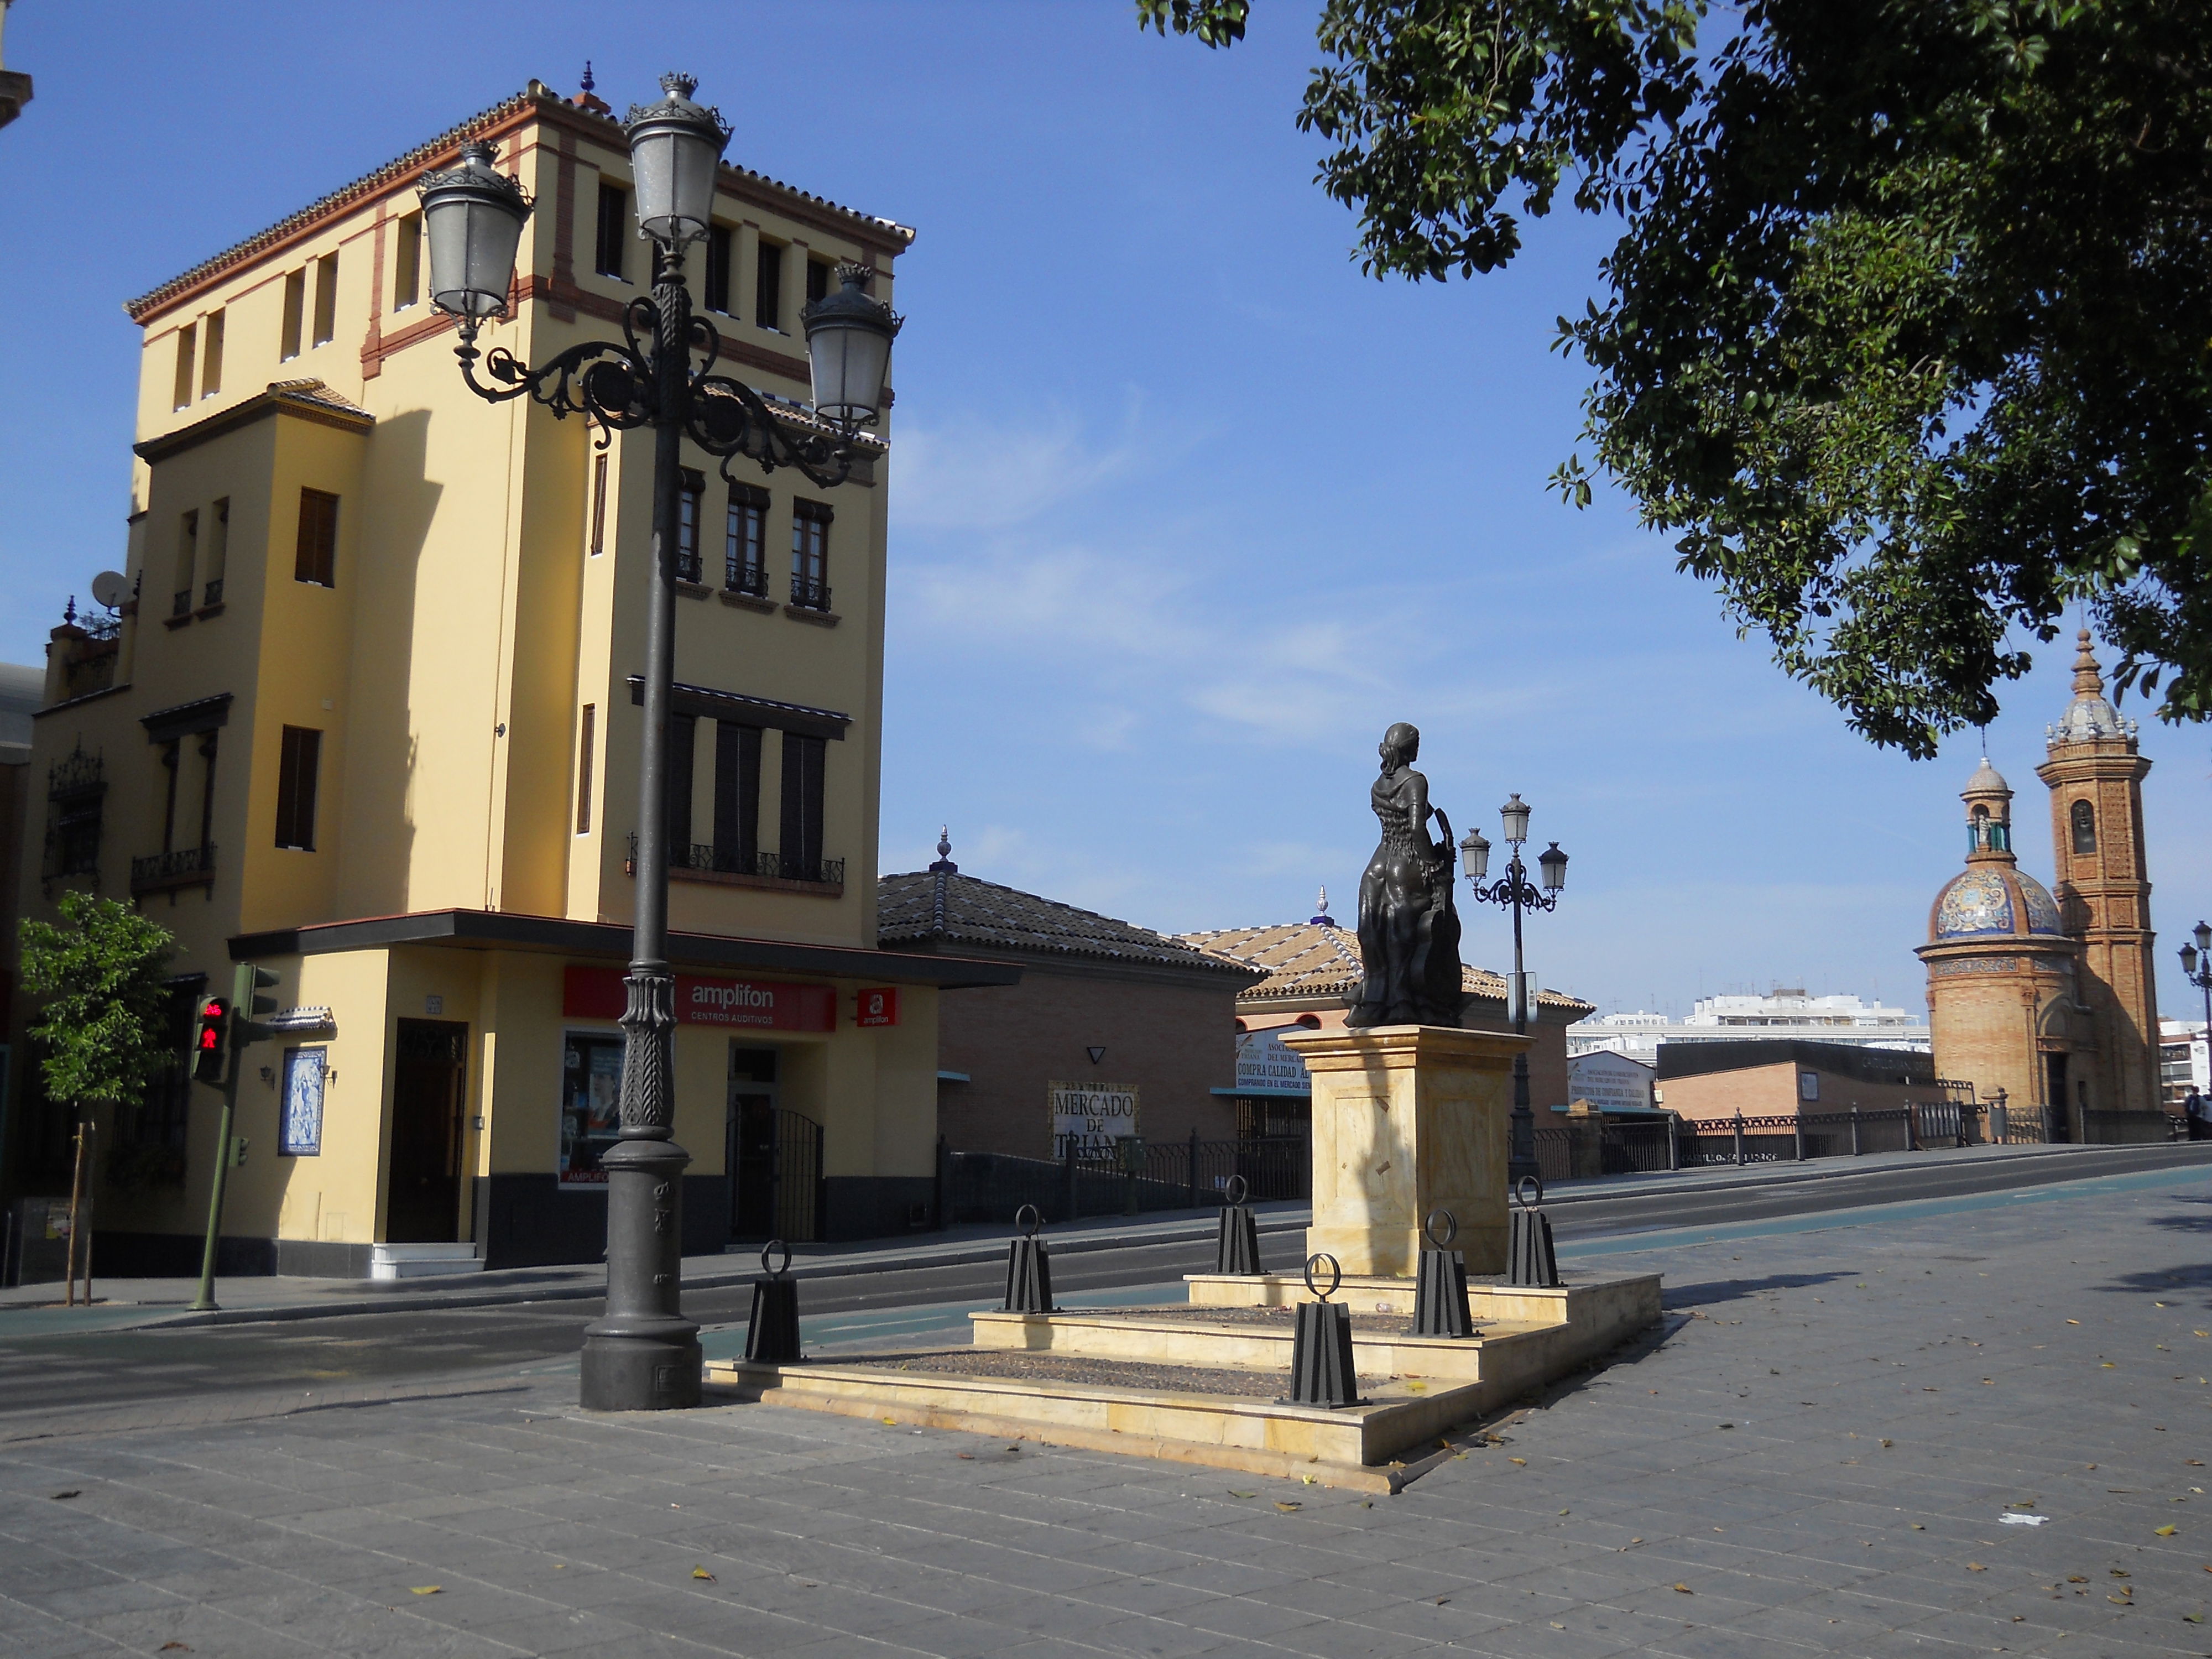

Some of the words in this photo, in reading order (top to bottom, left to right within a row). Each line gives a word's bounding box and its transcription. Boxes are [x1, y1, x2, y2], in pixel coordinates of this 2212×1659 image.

[692, 984, 774, 1010] amplifon
[692, 1011, 729, 1021] CENTROS
[732, 1014, 773, 1024] AUDITIVOS
[1238, 1063, 1266, 1076] COMPRA
[1268, 1065, 1296, 1078] CALIDAD
[1238, 1078, 1266, 1087] COMPRANDO
[1267, 1079, 1273, 1087] EN
[1274, 1079, 1279, 1088] EL
[1280, 1080, 1301, 1089] MERCADO
[1055, 1093, 1133, 1117] MERCADO
[1087, 1118, 1104, 1133] DE
[1055, 1134, 1117, 1160] TIAN
[568, 1172, 608, 1182] AMPLIFO
